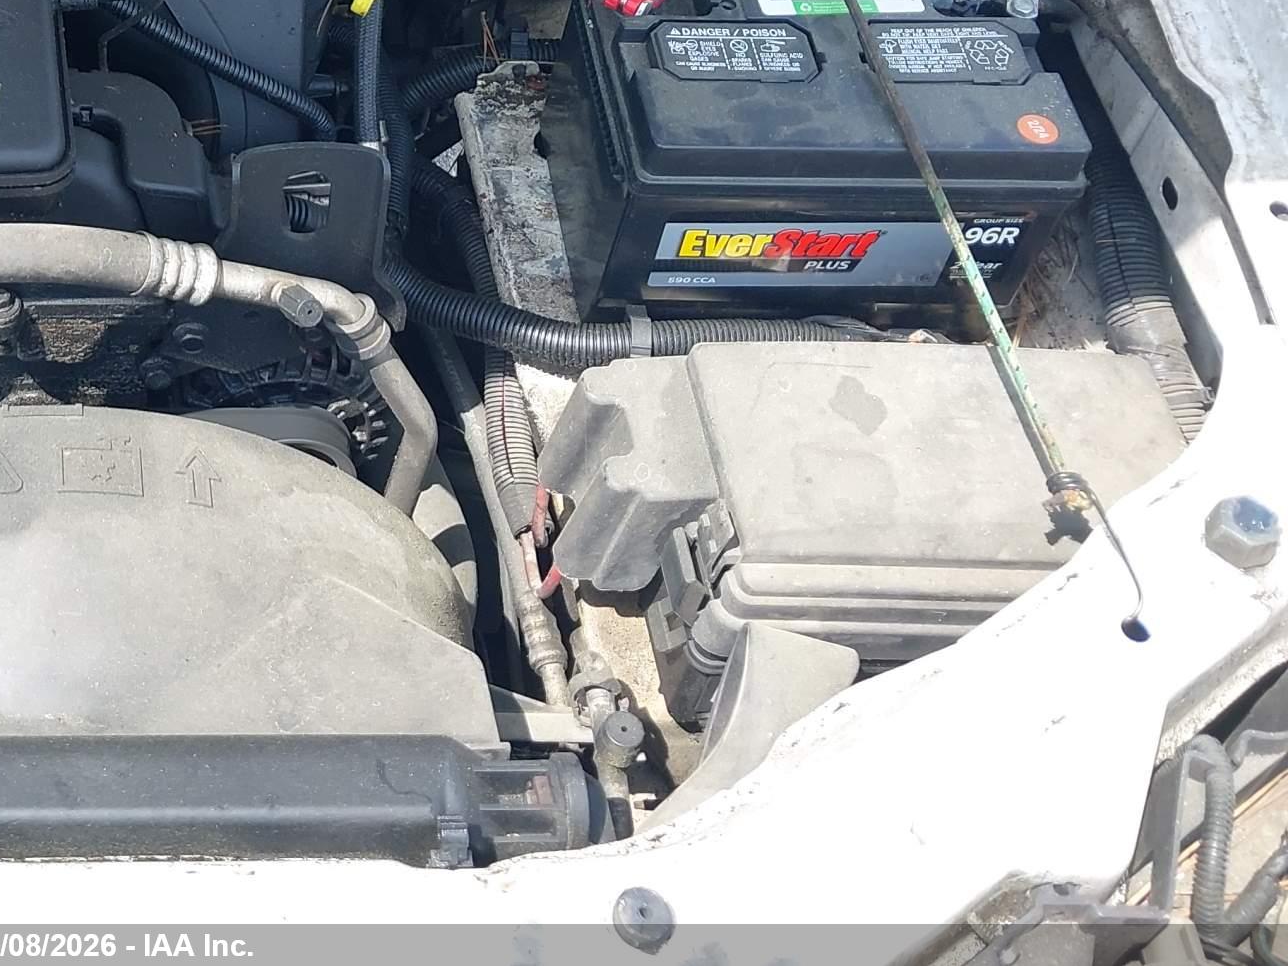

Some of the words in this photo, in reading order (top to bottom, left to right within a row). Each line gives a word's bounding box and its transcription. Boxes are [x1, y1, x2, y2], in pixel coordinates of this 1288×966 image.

[681, 27, 731, 36] DANGER
[733, 28, 740, 36] /
[742, 28, 787, 37] POISON
[964, 226, 1020, 244] 96R
[678, 228, 881, 258] EverStart
[804, 260, 850, 271] PLUS
[667, 276, 691, 284] 590
[692, 276, 716, 284] CCA
